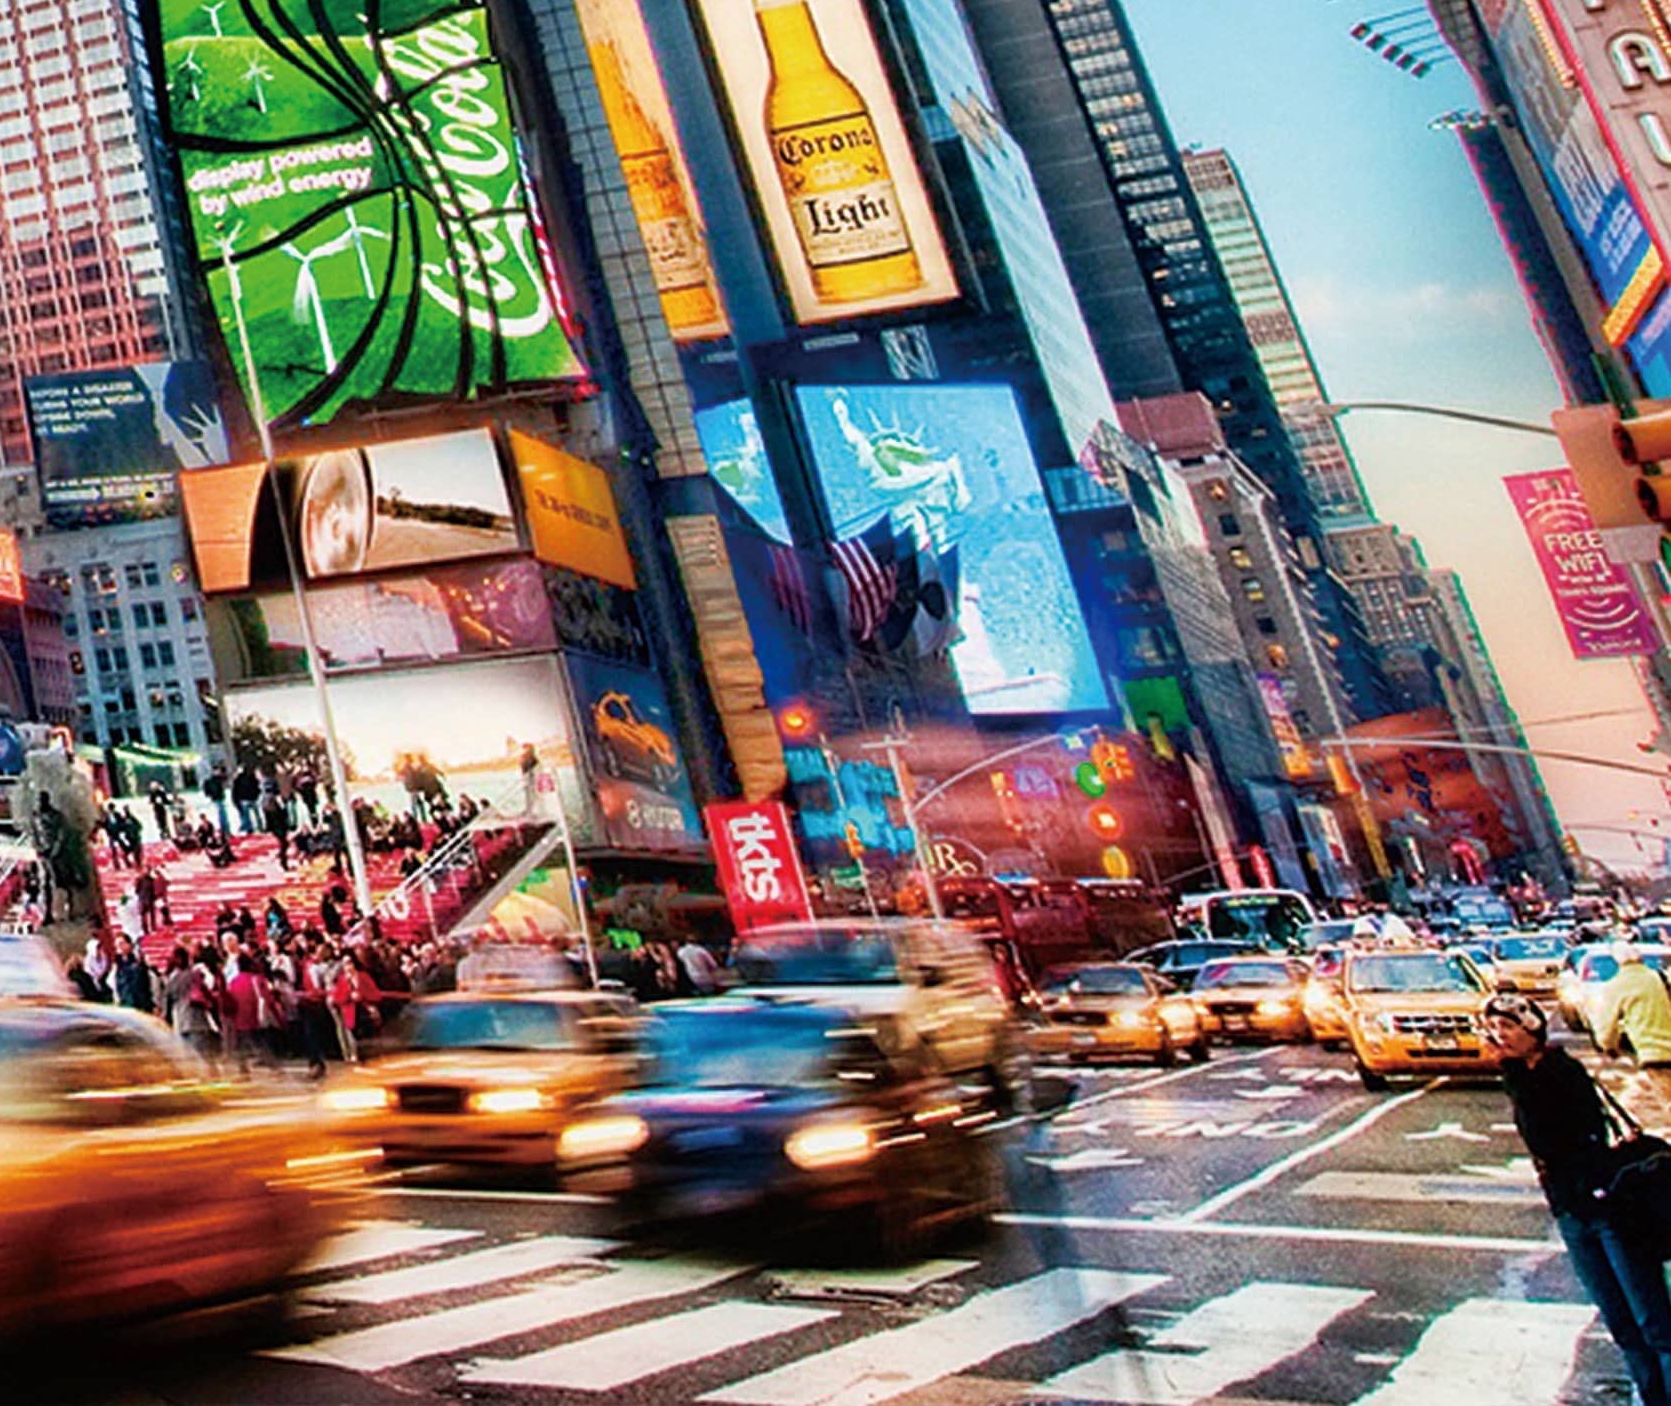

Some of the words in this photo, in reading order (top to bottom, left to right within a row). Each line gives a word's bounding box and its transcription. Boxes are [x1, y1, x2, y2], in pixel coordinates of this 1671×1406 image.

[188, 160, 266, 194] display
[270, 137, 373, 171] powered
[199, 190, 227, 216] by
[232, 178, 286, 205] wind
[289, 169, 372, 196] energy
[805, 194, 890, 239] Light
[1544, 529, 1603, 552] FREE
[729, 811, 783, 903] tkts
